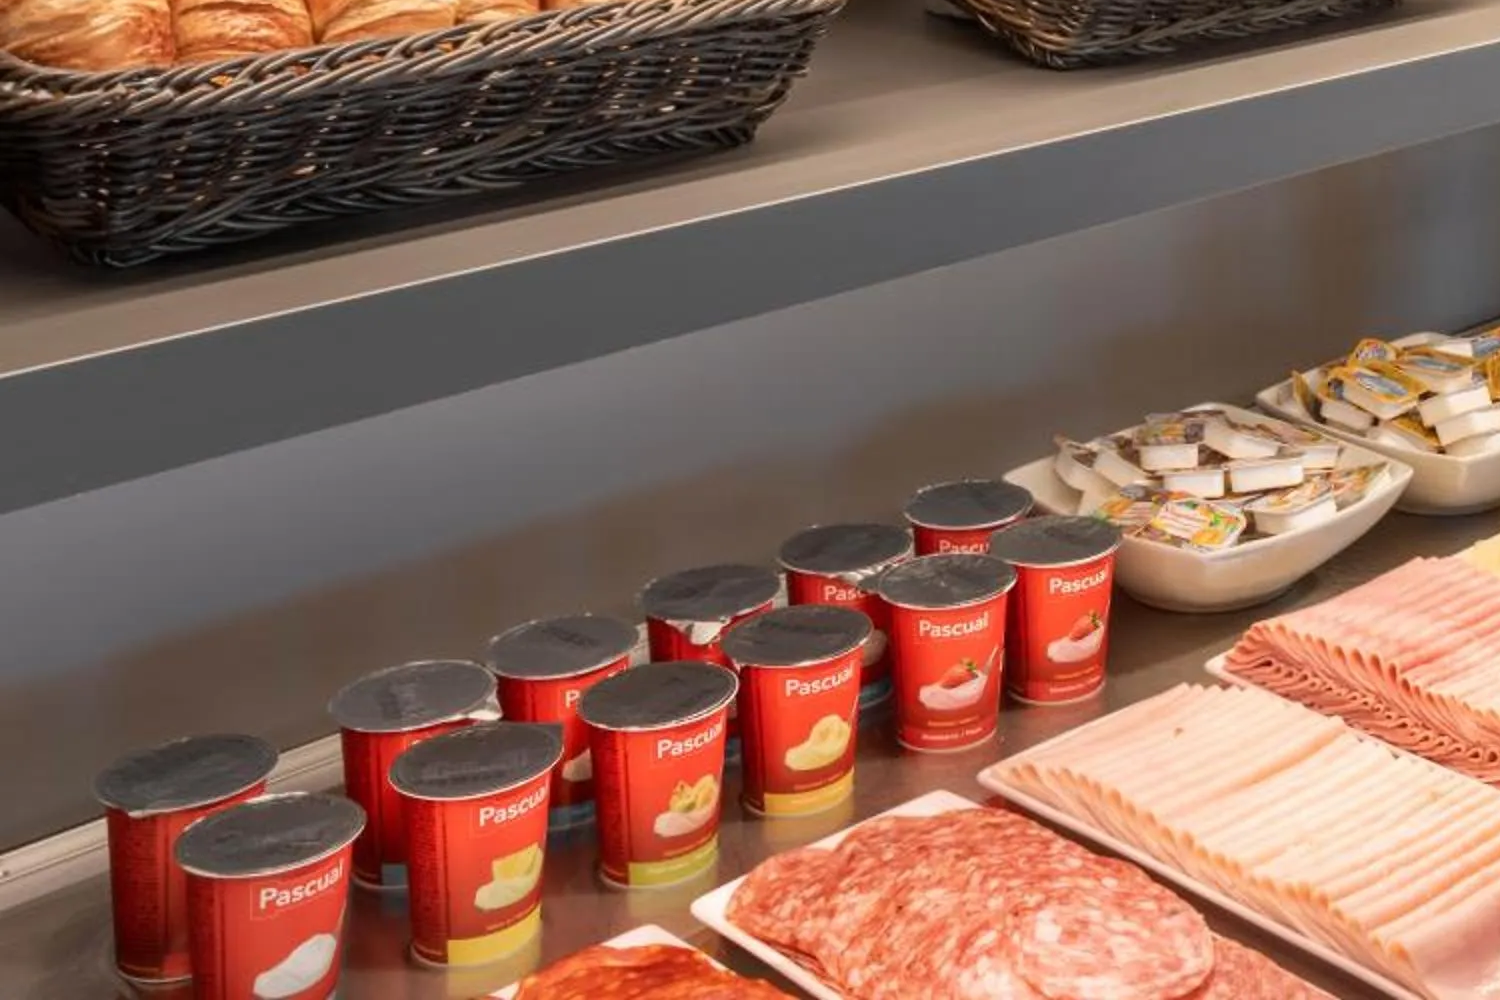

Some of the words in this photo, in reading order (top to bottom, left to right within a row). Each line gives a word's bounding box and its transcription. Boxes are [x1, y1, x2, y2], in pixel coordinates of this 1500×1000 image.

[938, 539, 990, 554] Pascu
[919, 610, 989, 637] Pascual
[785, 660, 854, 697] Pascual
[259, 858, 344, 910] Pascual
